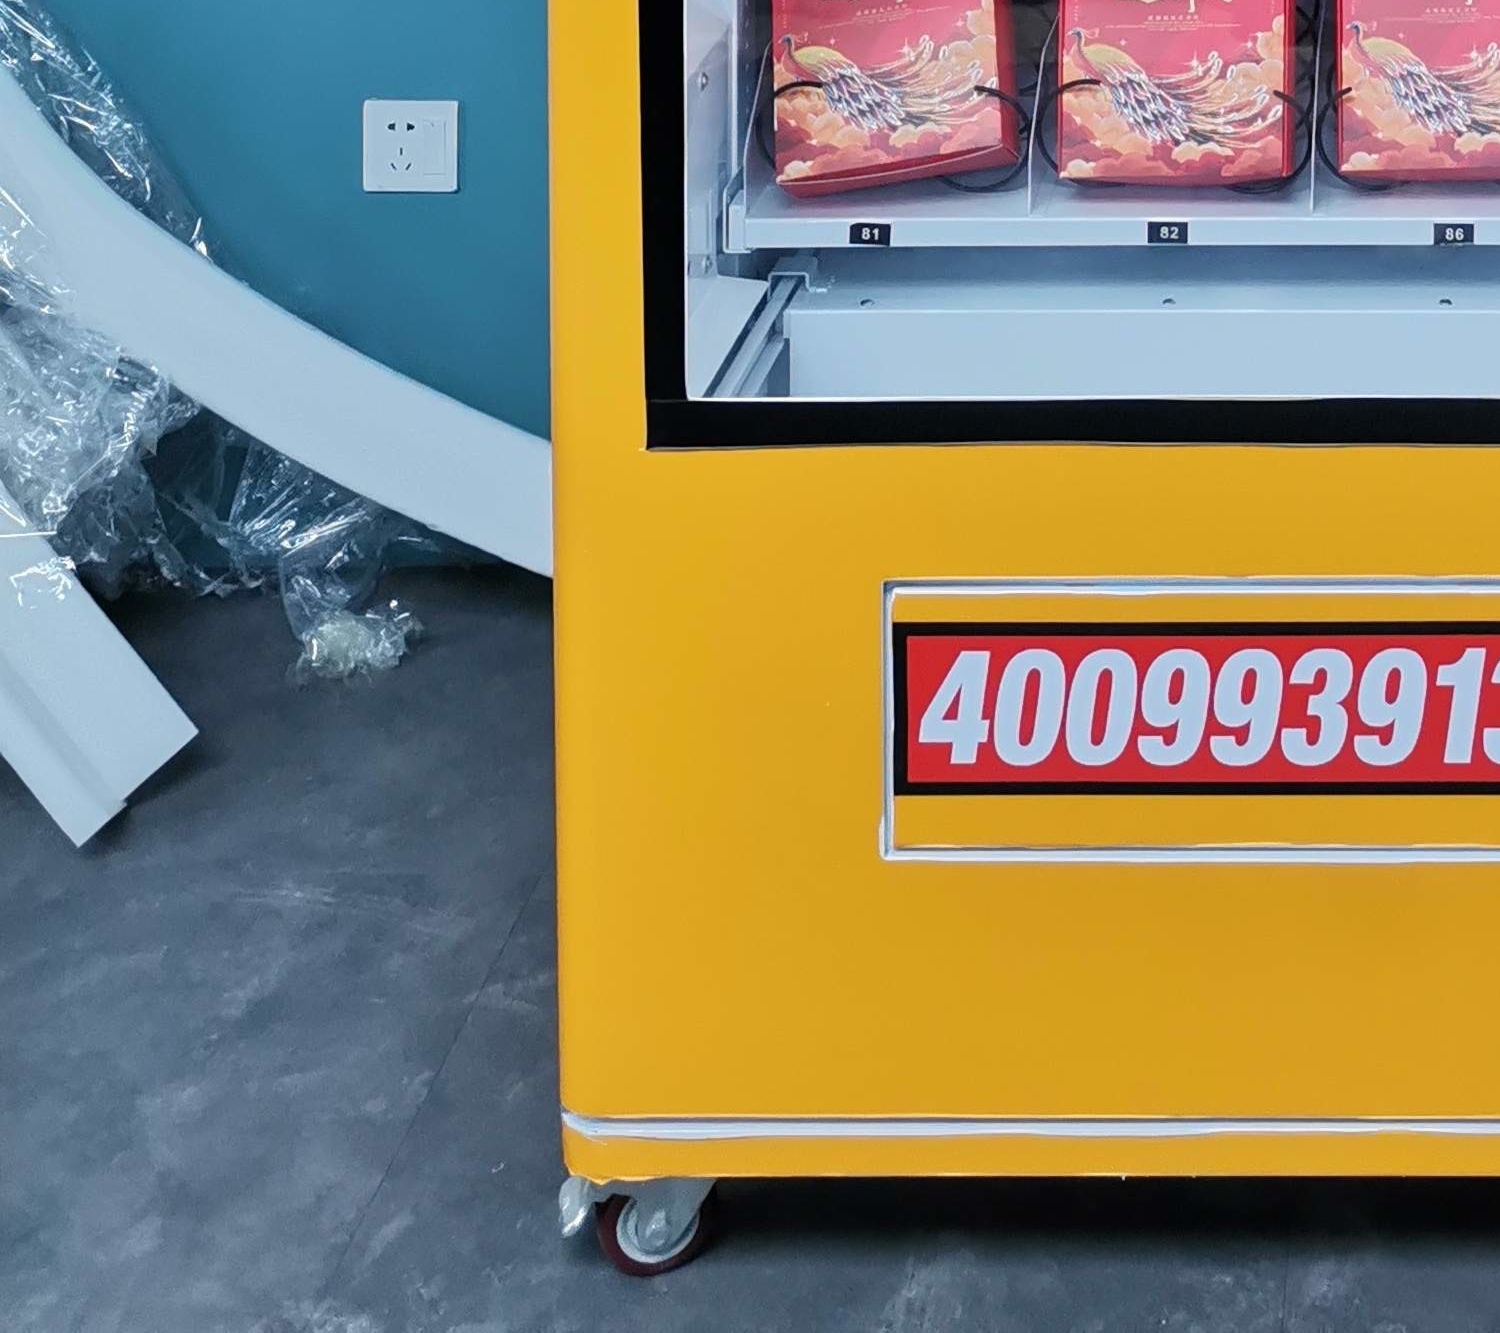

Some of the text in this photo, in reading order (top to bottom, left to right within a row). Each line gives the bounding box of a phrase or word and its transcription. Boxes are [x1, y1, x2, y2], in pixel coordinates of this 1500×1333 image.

[862, 227, 880, 240] 81
[1159, 226, 1179, 239] 82
[1445, 228, 1464, 241] 86
